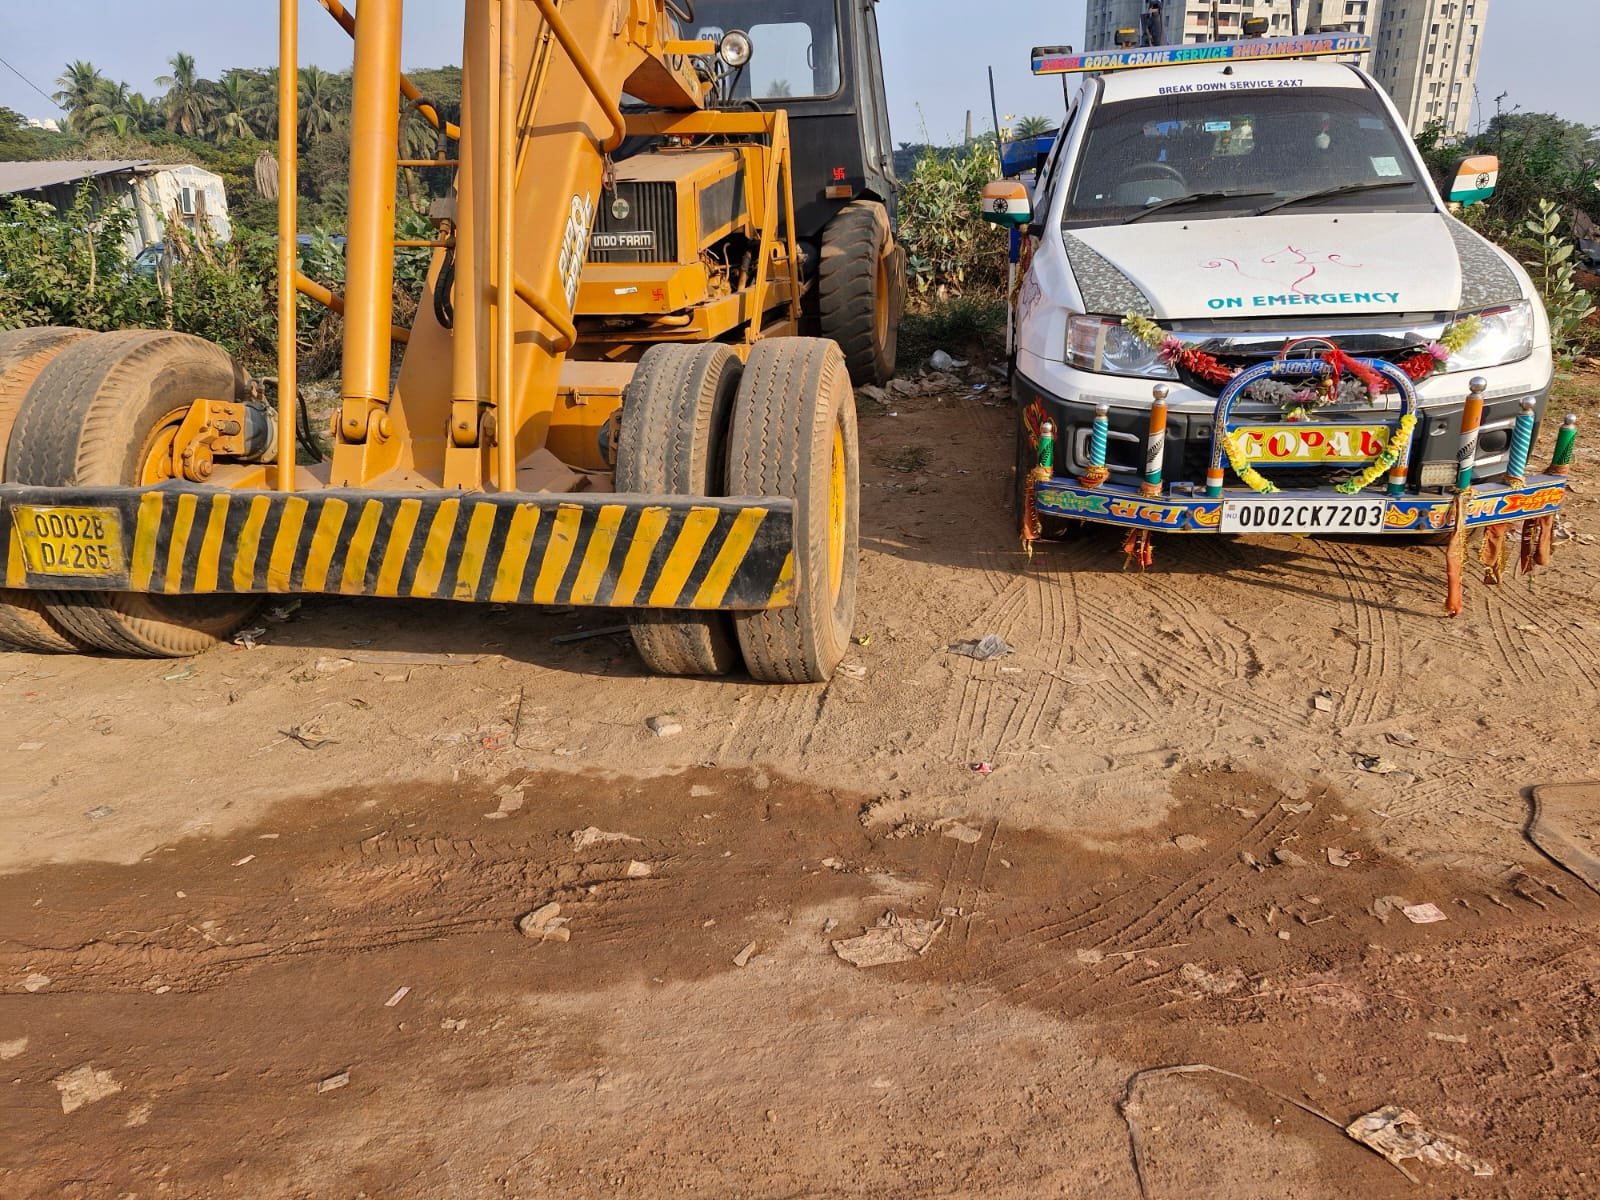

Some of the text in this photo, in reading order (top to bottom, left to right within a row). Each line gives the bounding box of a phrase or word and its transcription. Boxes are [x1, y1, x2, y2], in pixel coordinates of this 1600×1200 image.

[1084, 54, 1125, 68] GOPAL
[1127, 51, 1170, 65] CRANE
[1174, 46, 1228, 62] SERVICE
[1232, 39, 1334, 58] BHUBANESWAR
[1336, 37, 1367, 51] CITY
[1158, 79, 1304, 95] BREAK DOWN SERVICE 24X7
[593, 234, 651, 247] INDO FARM
[1207, 292, 1400, 310] ON EMERGENCY
[1237, 430, 1383, 458] GOPAL
[1239, 505, 1382, 527] OD02CK7203
[41, 542, 112, 570] D4265
